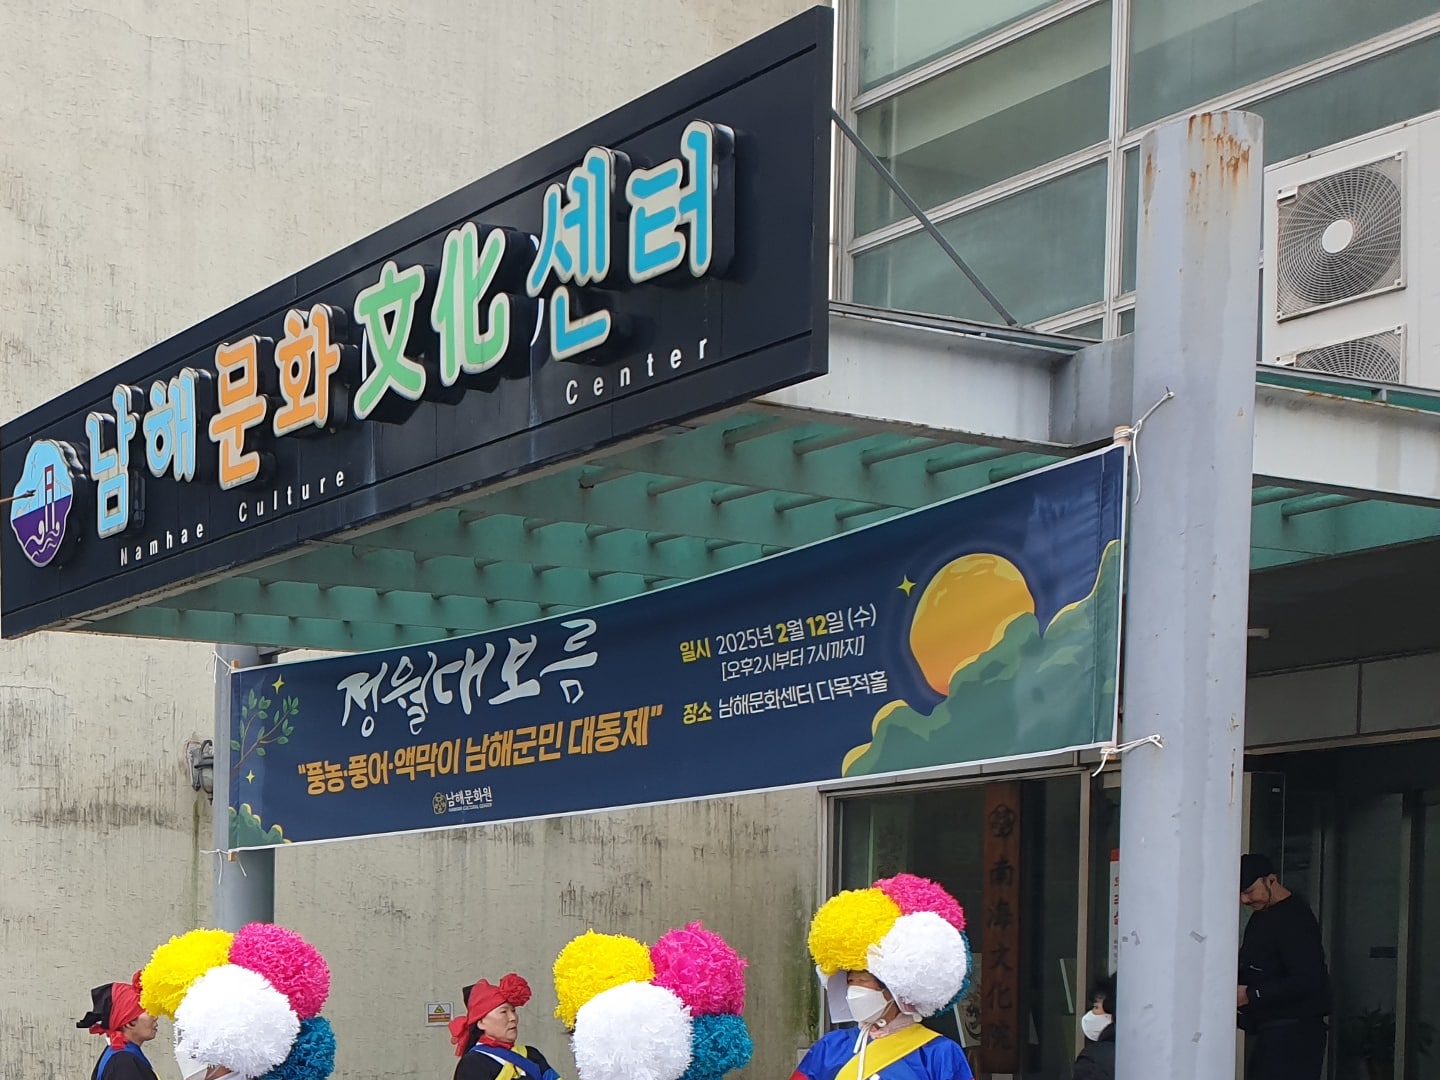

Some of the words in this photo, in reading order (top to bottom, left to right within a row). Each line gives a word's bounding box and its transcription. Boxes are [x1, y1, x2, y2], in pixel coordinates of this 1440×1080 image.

[120, 522, 205, 567] Namhae
[238, 470, 345, 523] Culture
[565, 337, 709, 406] Center
[679, 637, 712, 663] 일시
[715, 625, 775, 655] 2025년
[775, 618, 806, 644] 2월
[806, 610, 845, 637] 12일
[847, 603, 877, 631] (수)
[336, 618, 599, 738] 정월대보름
[682, 701, 713, 725] 장소
[718, 683, 815, 719] 남해문화센터
[816, 669, 889, 702] 다목적홀
[465, 721, 564, 773] 남해군민
[445, 786, 493, 808] 남해문화원
